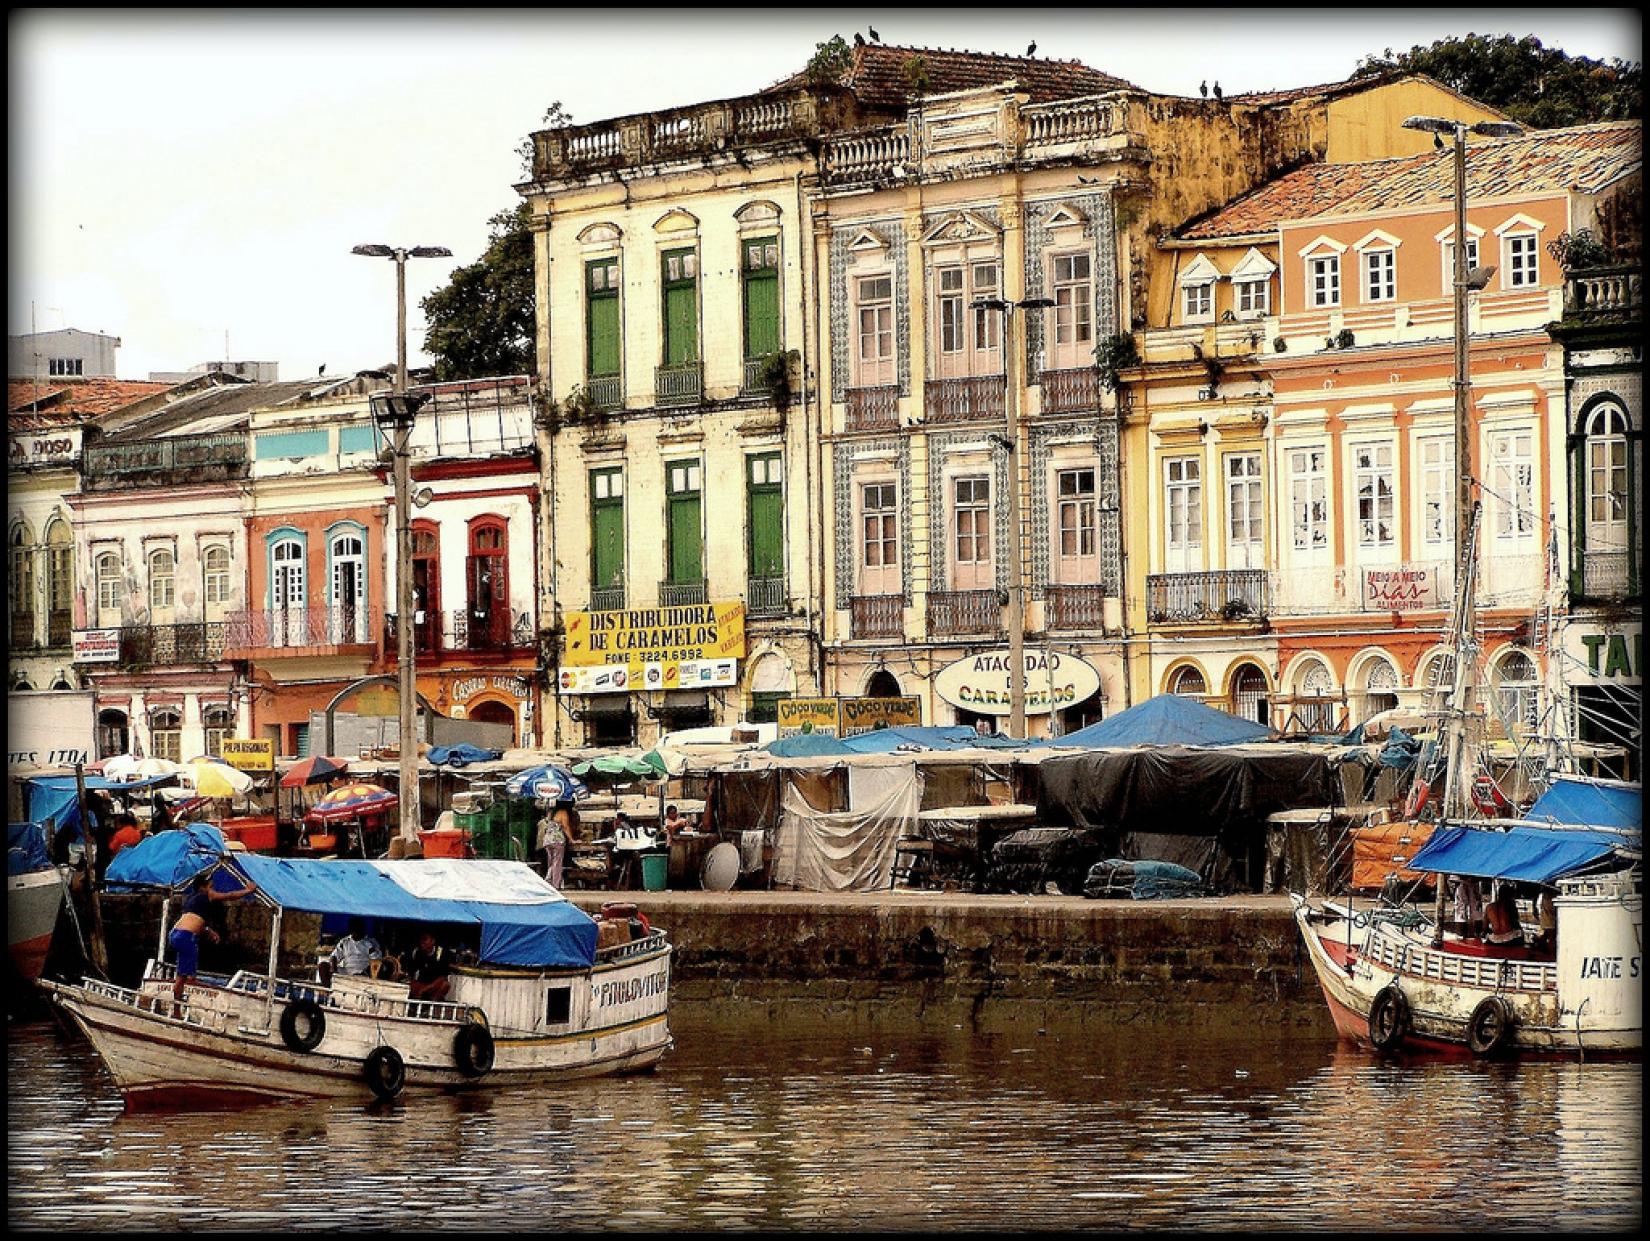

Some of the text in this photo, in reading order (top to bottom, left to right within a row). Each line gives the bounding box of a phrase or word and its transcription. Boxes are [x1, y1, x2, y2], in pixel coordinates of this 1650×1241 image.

[1402, 571, 1427, 583] MEIO
[1376, 600, 1424, 610] ALIMENTOS
[590, 605, 716, 631] DISTRIBUIDORA
[589, 626, 718, 651] DE CARAMELOS
[605, 649, 703, 664] FONE 3224.6992
[1006, 676, 1028, 689] DS
[958, 683, 1076, 705] CARAELOS
